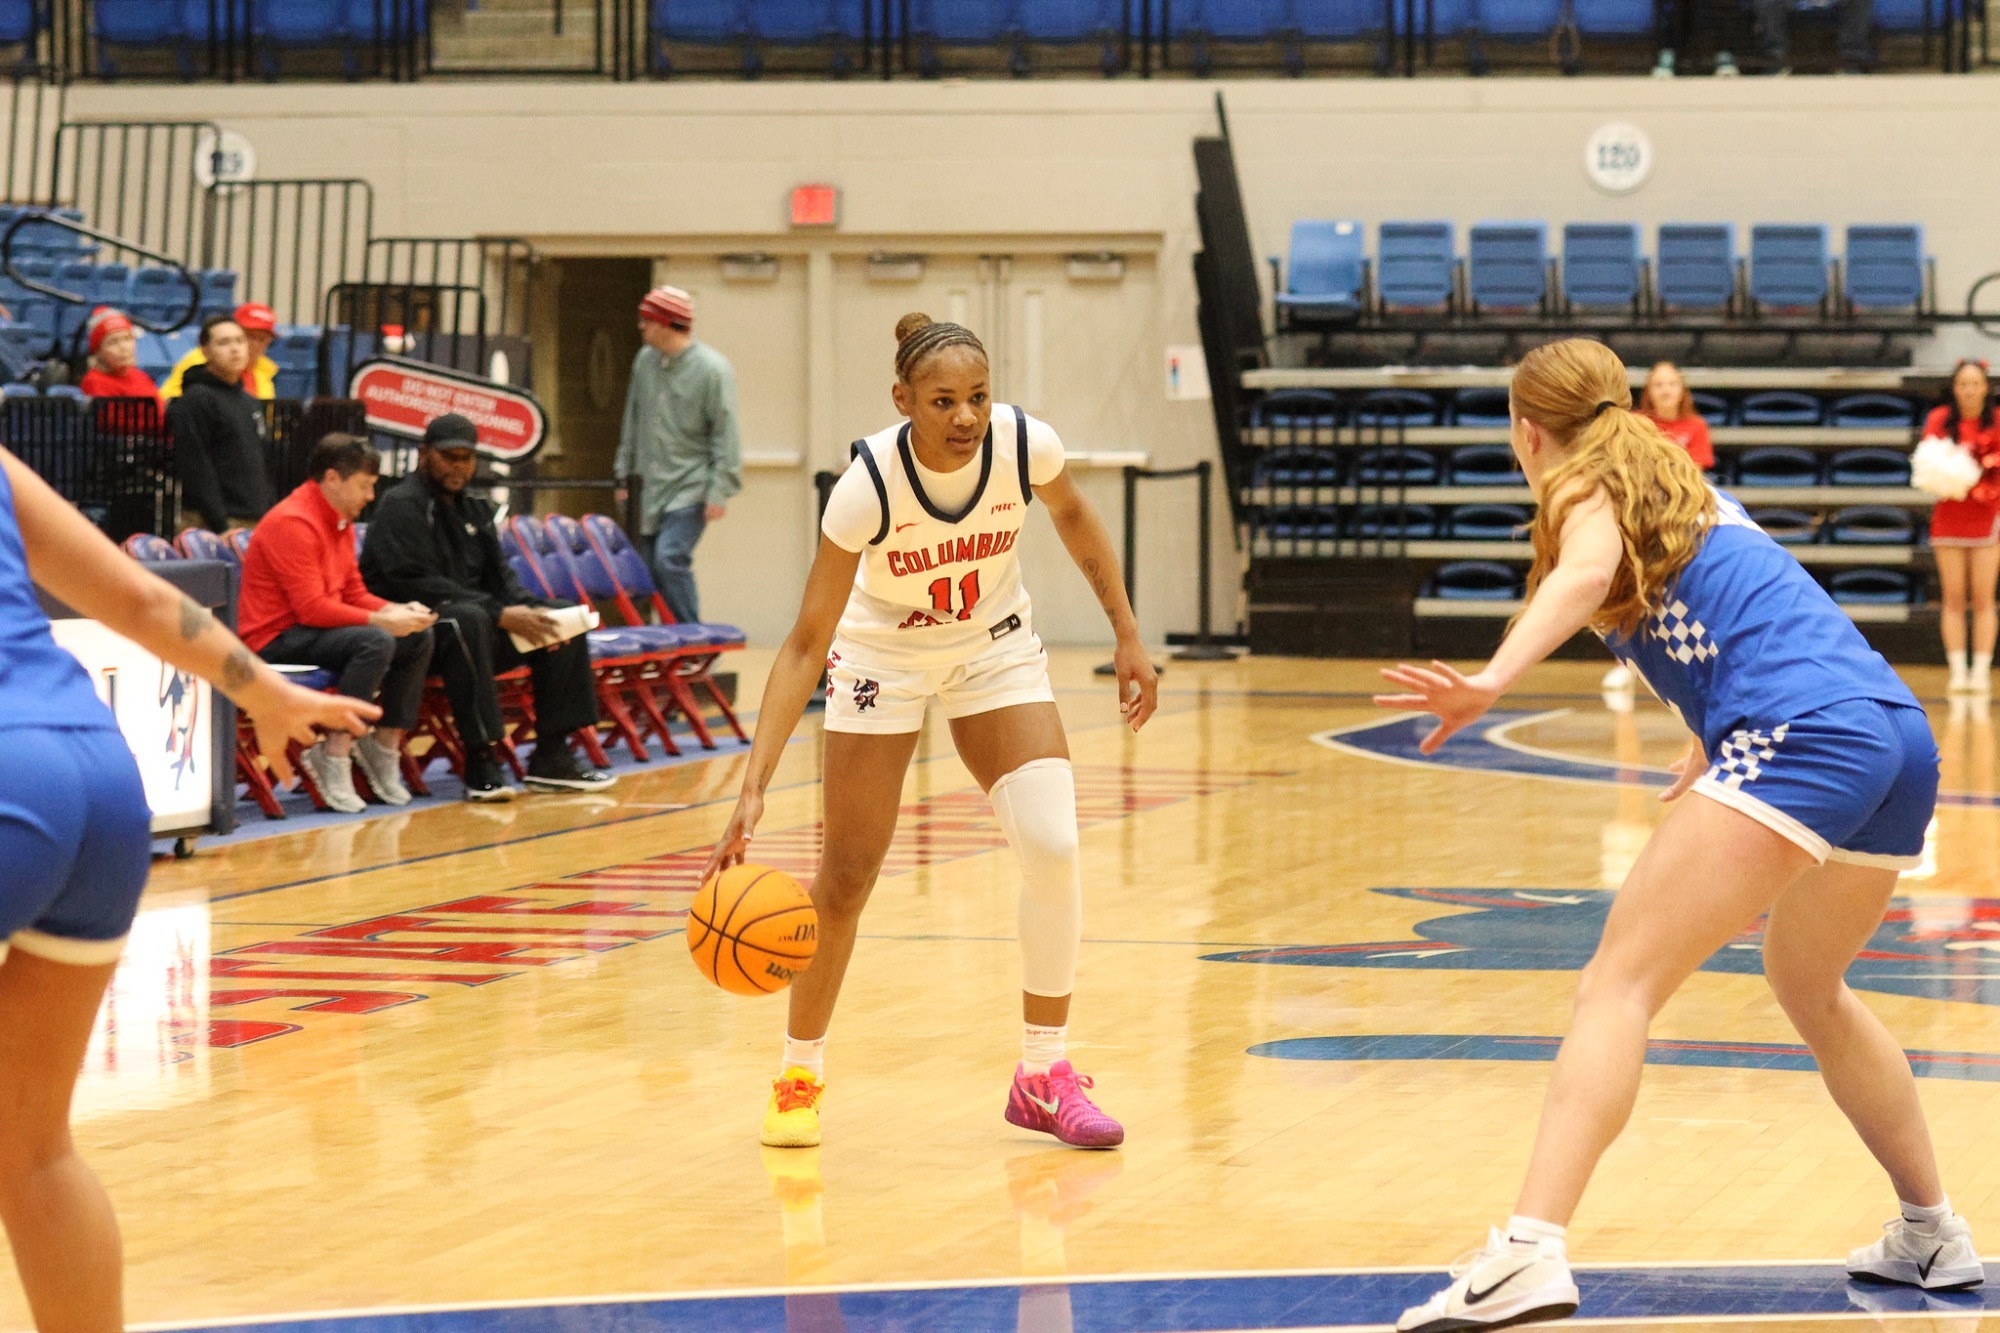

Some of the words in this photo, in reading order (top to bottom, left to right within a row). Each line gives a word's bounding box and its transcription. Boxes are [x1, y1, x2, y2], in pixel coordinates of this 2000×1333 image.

[1597, 143, 1641, 171] 120
[887, 527, 1020, 578] COLUMBUS
[928, 568, 981, 622] 11
